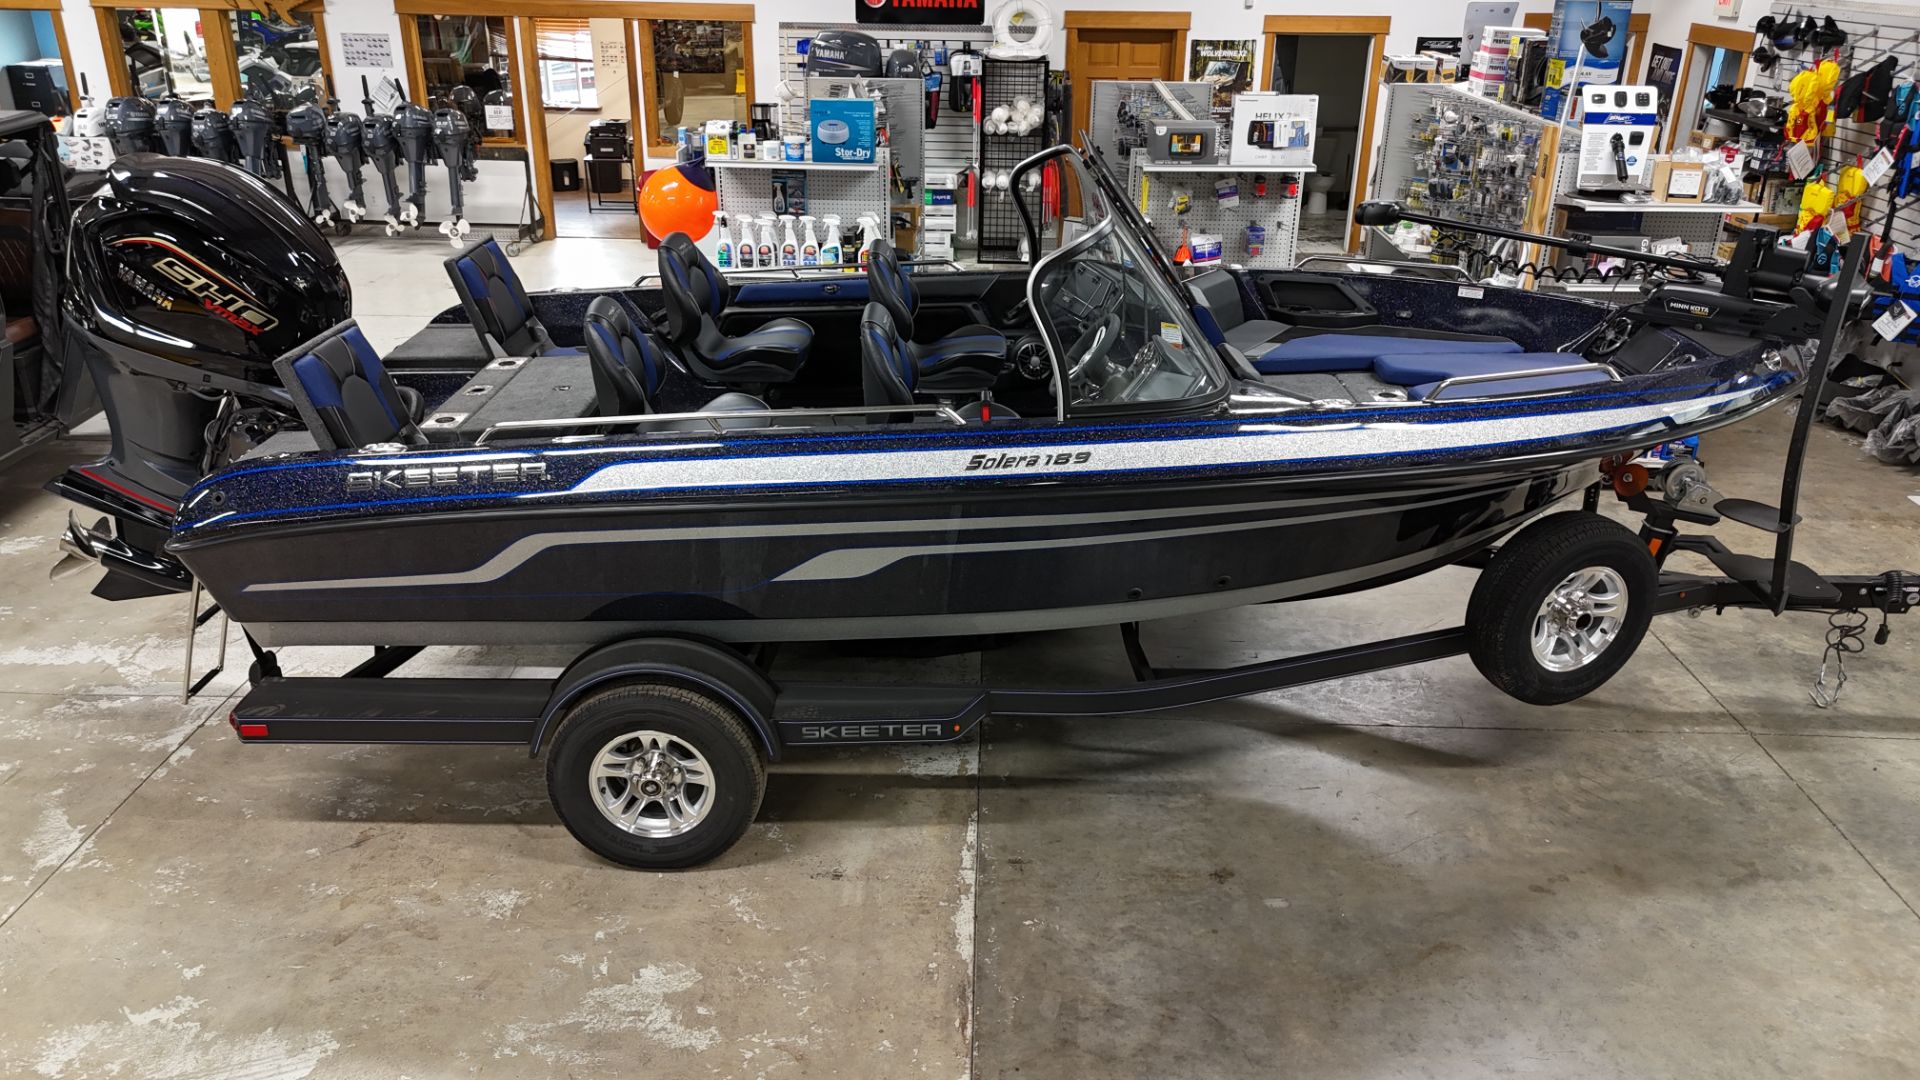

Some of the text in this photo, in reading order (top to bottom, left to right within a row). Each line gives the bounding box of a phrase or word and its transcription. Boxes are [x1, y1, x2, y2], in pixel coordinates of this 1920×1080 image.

[815, 46, 846, 60] YAMAHA
[1255, 112, 1285, 120] HELIX
[835, 147, 871, 159] Stor-Dry
[152, 257, 279, 331] SHO
[1669, 302, 1690, 310] MINN
[1690, 305, 1710, 313] KOTA
[965, 451, 1092, 471] Solera 189
[347, 462, 548, 492] SKEETER
[801, 724, 942, 739] SKEETER
